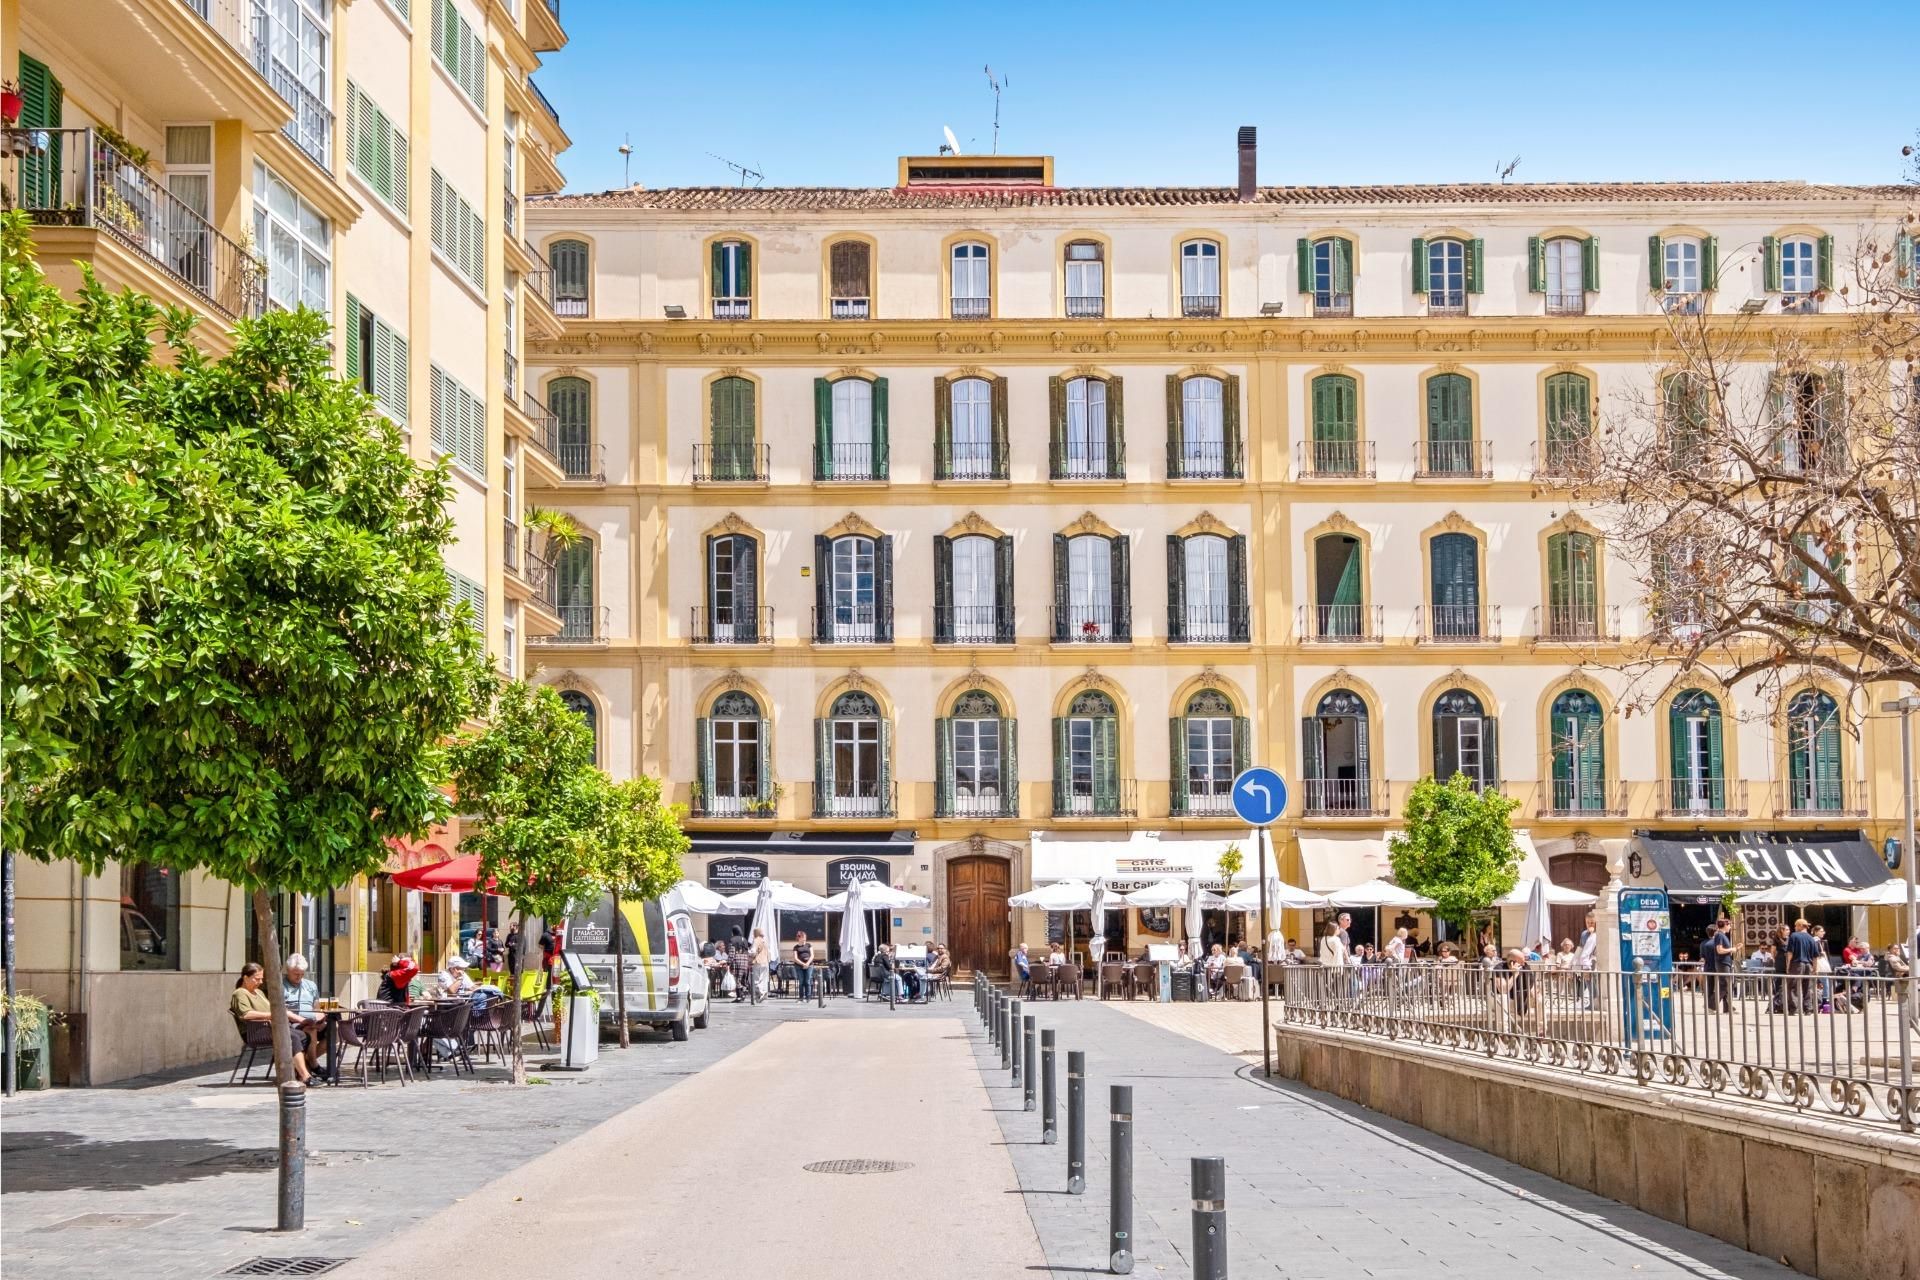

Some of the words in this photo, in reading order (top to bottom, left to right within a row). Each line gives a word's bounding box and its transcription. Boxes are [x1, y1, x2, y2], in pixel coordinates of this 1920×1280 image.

[716, 864, 738, 872] TAPAS
[840, 863, 876, 871] ESQUINA
[1683, 847, 1740, 882] EL
[1735, 848, 1854, 884] CLAN
[840, 871, 877, 880] KANAYA
[1111, 881, 1130, 890] Bar
[1640, 898, 1660, 906] DESA
